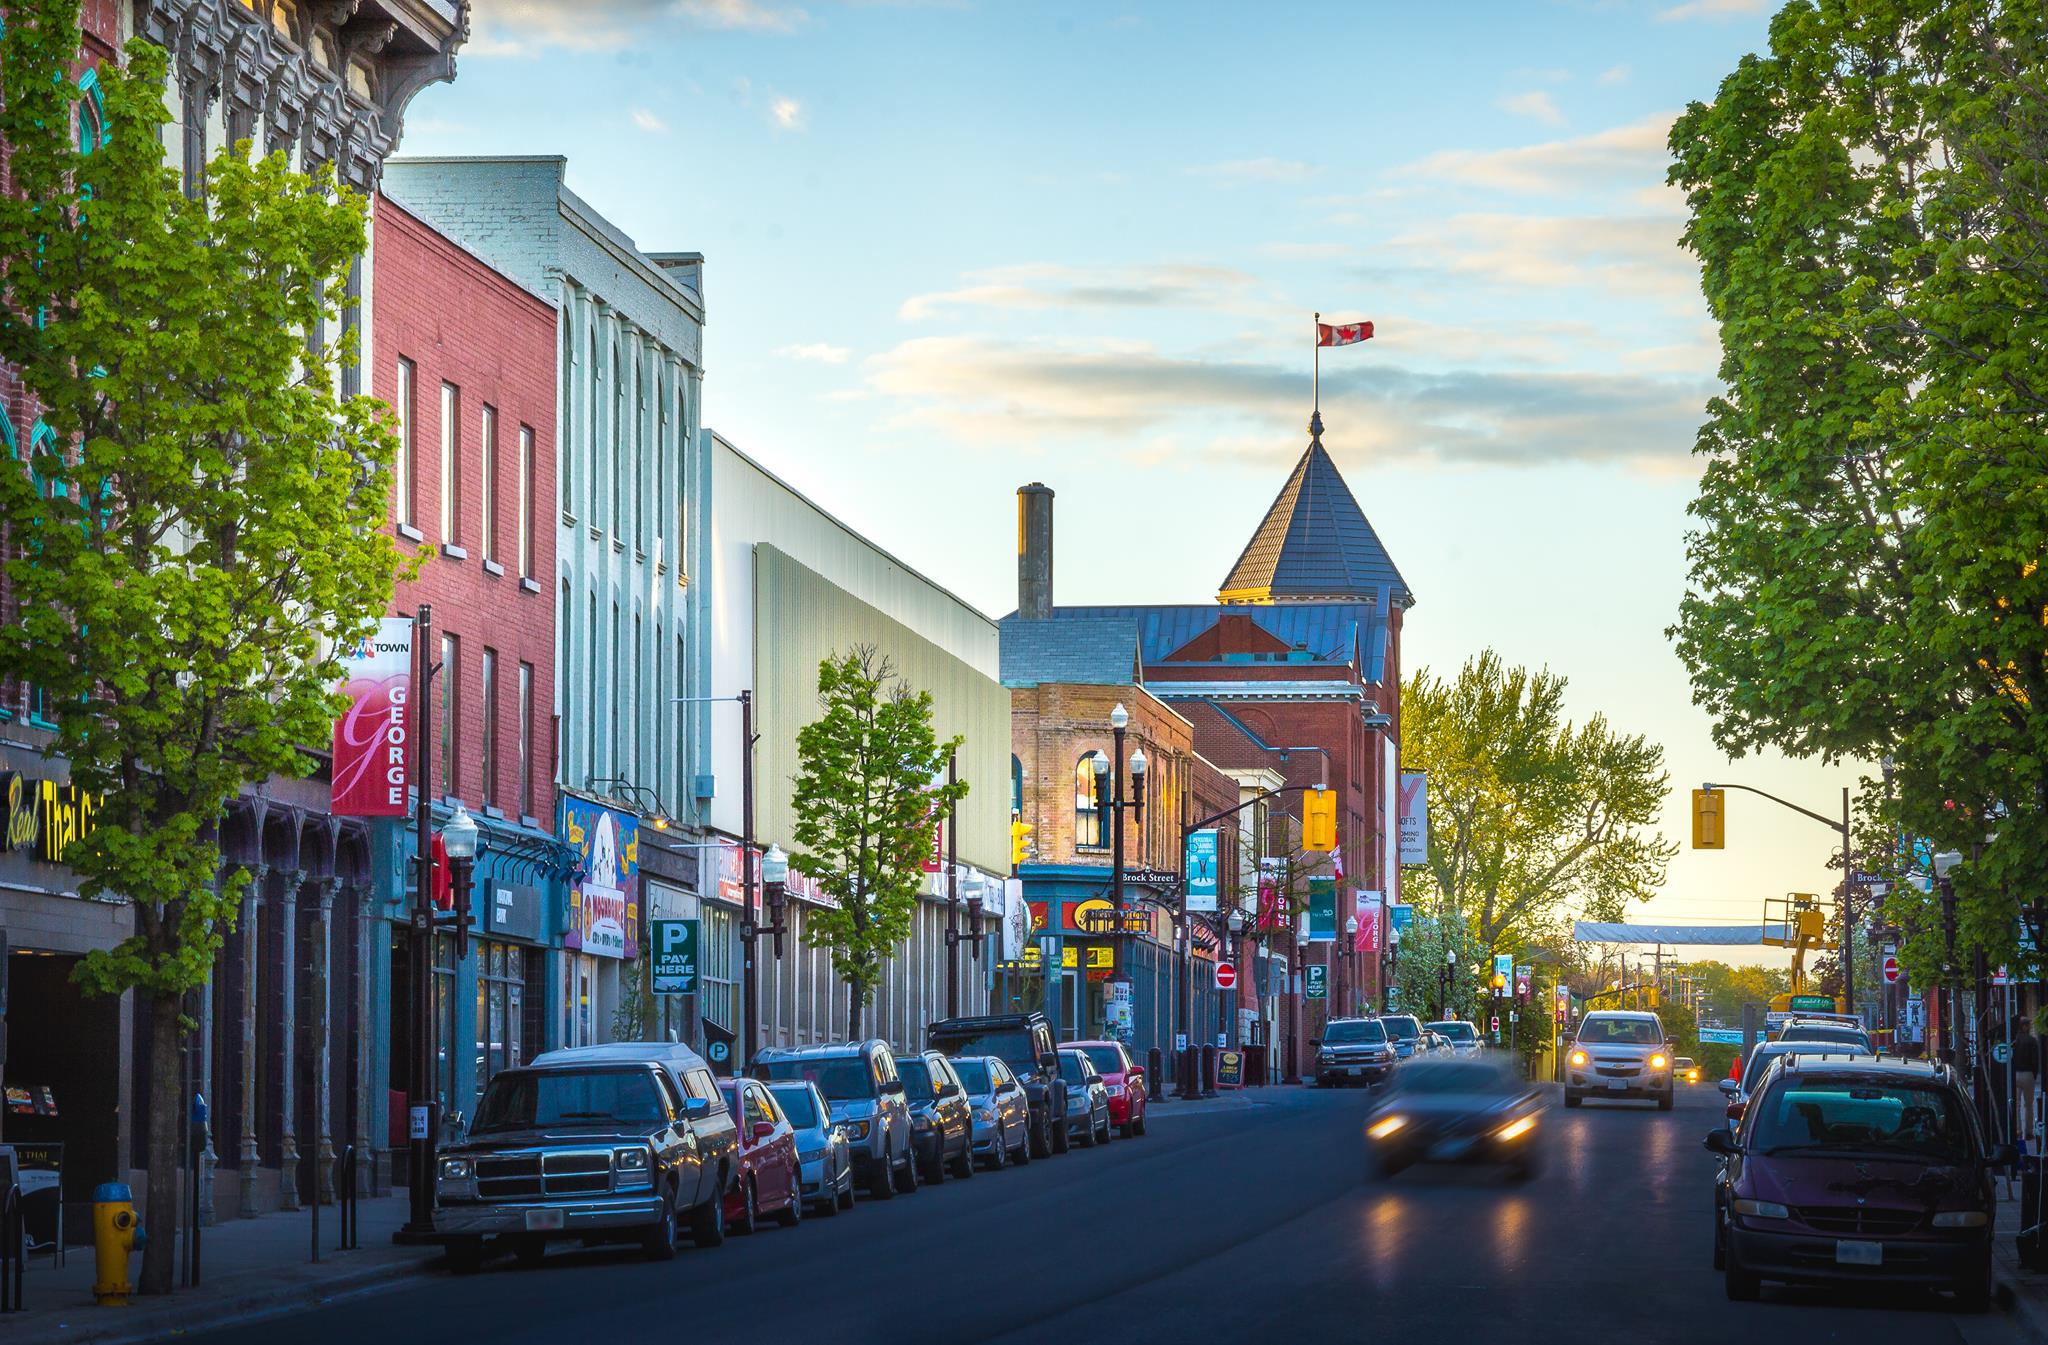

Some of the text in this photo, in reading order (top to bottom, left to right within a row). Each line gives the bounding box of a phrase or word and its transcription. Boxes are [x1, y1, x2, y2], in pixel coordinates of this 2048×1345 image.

[387, 686, 406, 805] GEORGE
[43, 779, 76, 862] Thai
[1400, 817, 1417, 826] OFTS
[1122, 873, 1174, 882] Brock Street
[1857, 873, 1883, 882] Brock
[663, 923, 688, 953] P
[661, 954, 689, 964] PAY
[655, 965, 695, 974] HERE
[1310, 966, 1323, 980] P
[714, 1044, 726, 1058] P
